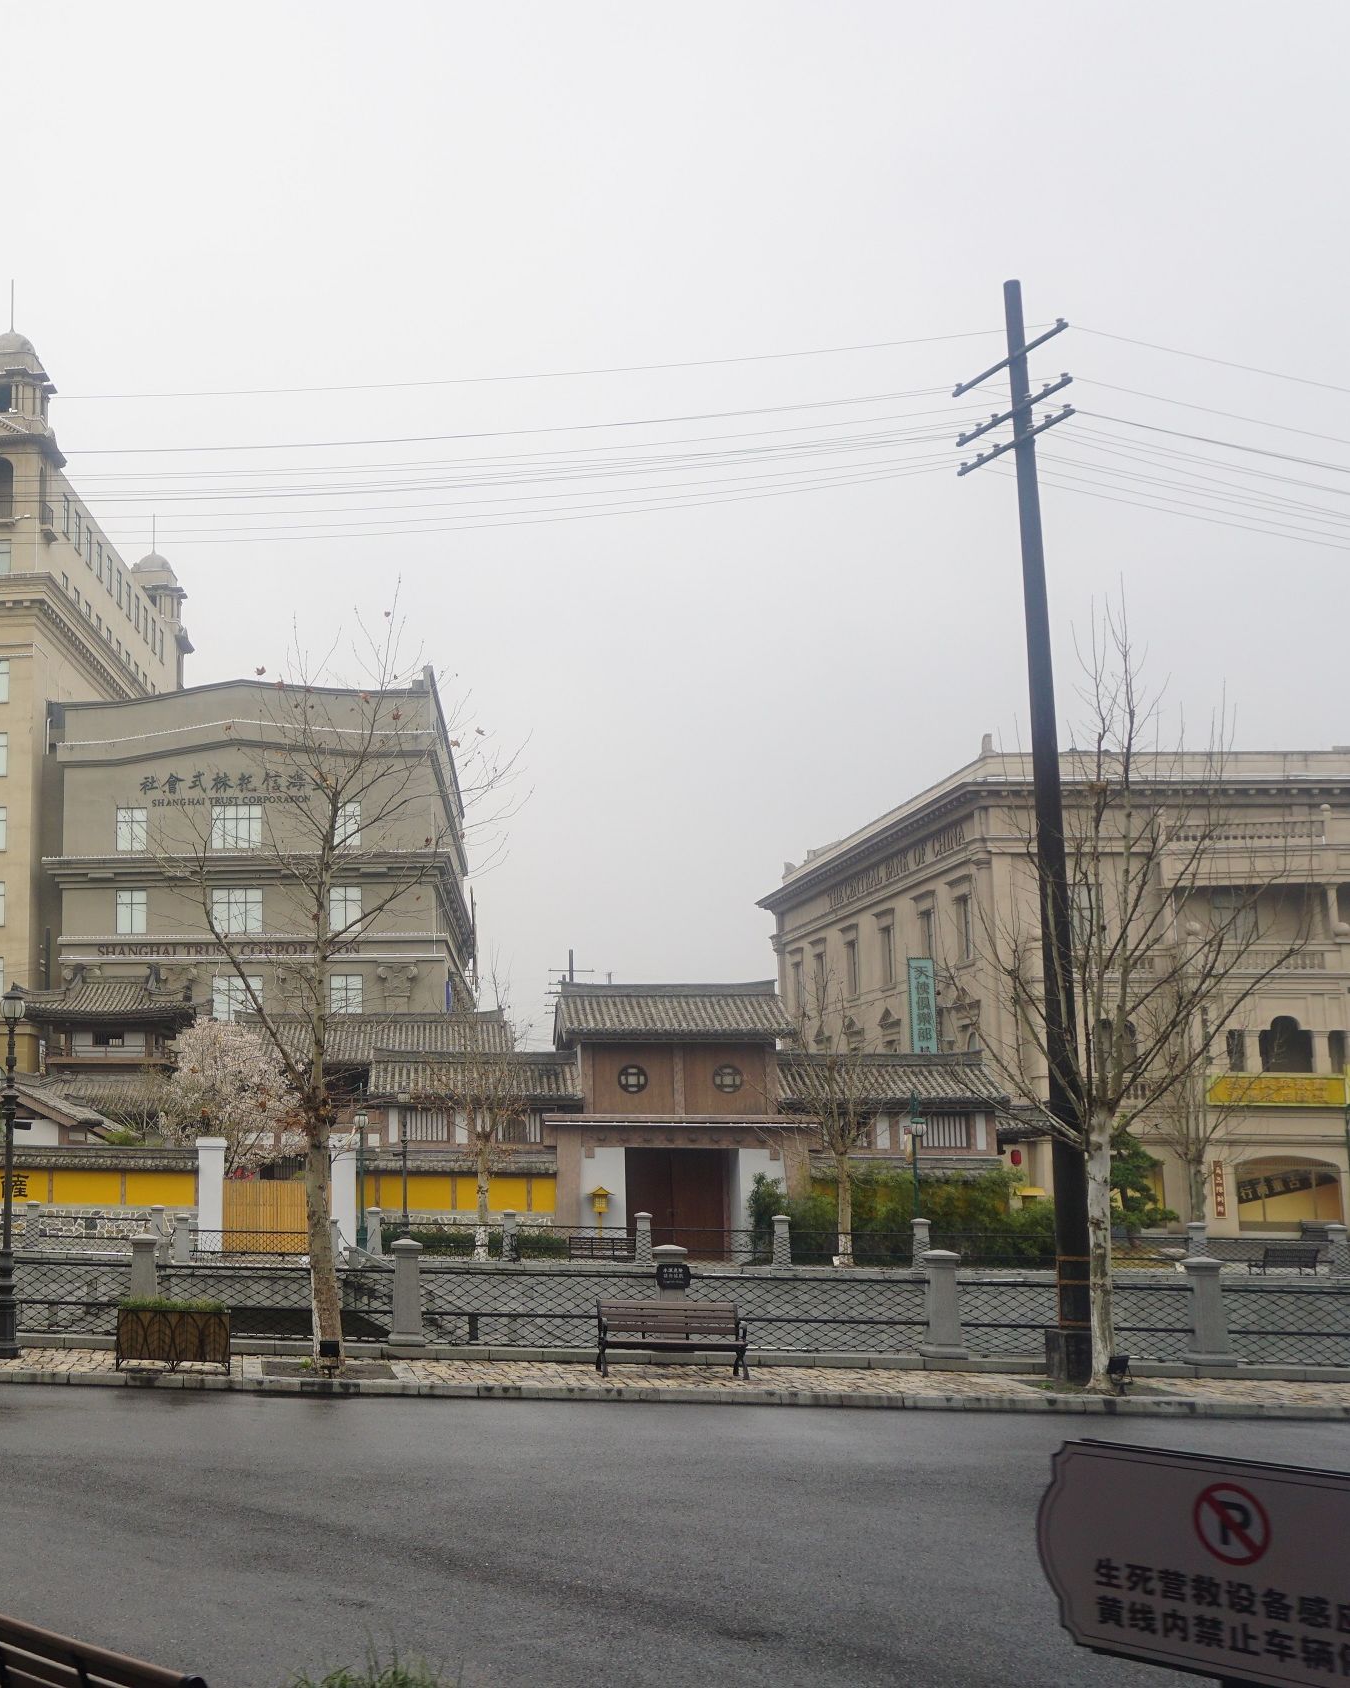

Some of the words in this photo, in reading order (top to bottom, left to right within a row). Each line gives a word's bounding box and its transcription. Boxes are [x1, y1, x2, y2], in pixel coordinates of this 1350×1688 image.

[152, 797, 205, 807] SHANGHAI
[209, 796, 240, 806] TRUST
[97, 943, 178, 957] SHANGHAI
[184, 944, 234, 957] TRUST
